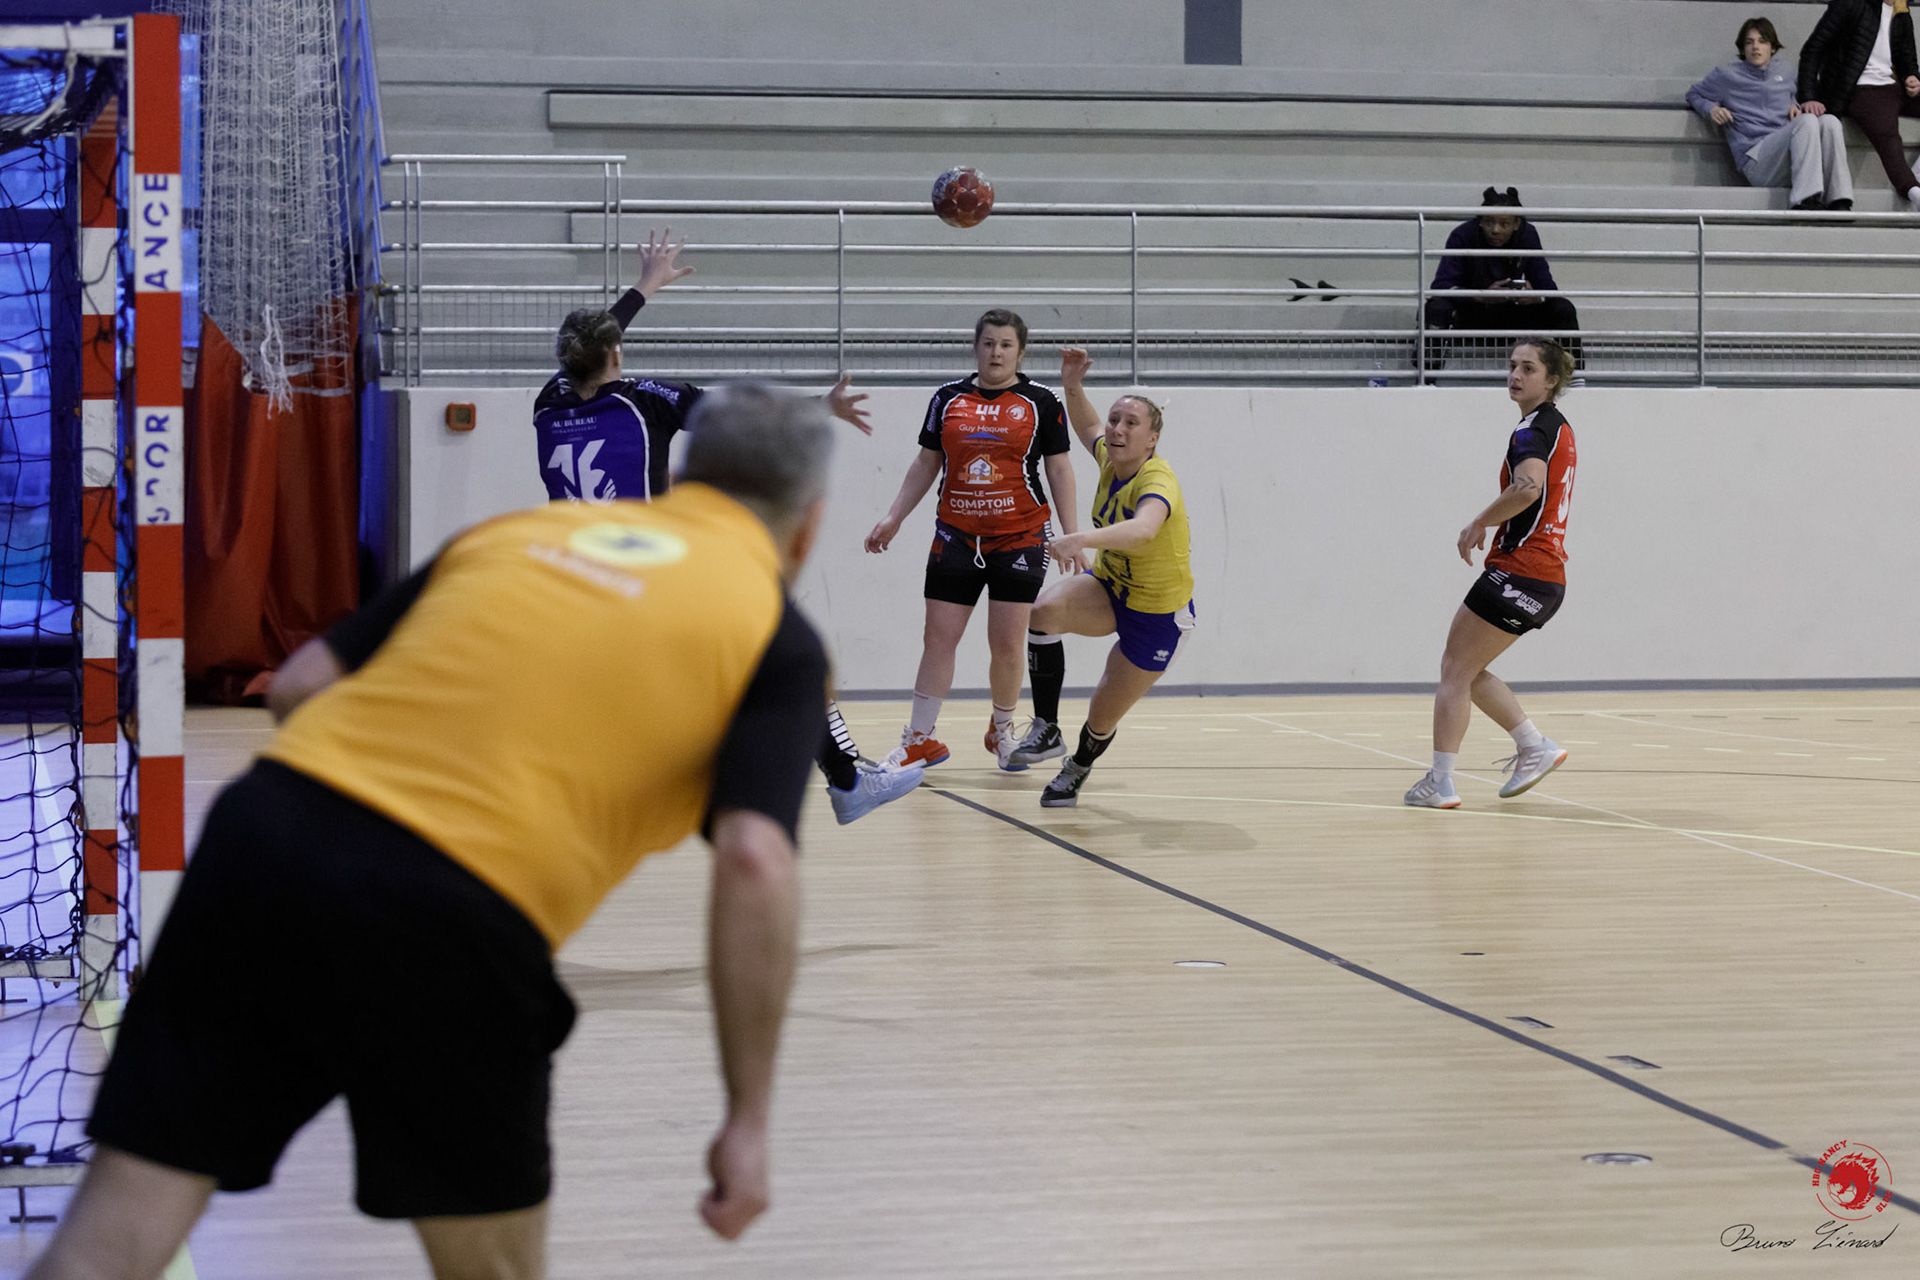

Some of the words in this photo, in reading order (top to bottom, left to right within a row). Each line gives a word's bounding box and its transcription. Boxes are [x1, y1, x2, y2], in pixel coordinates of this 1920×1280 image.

[975, 404, 1001, 422] 44
[958, 423, 976, 433] Guy
[977, 424, 1009, 434] Hoquet
[547, 439, 617, 504] 16
[949, 496, 1015, 509] COMPTOIR
[1515, 599, 1539, 615] SPORT
[1520, 593, 1543, 610] INTER
